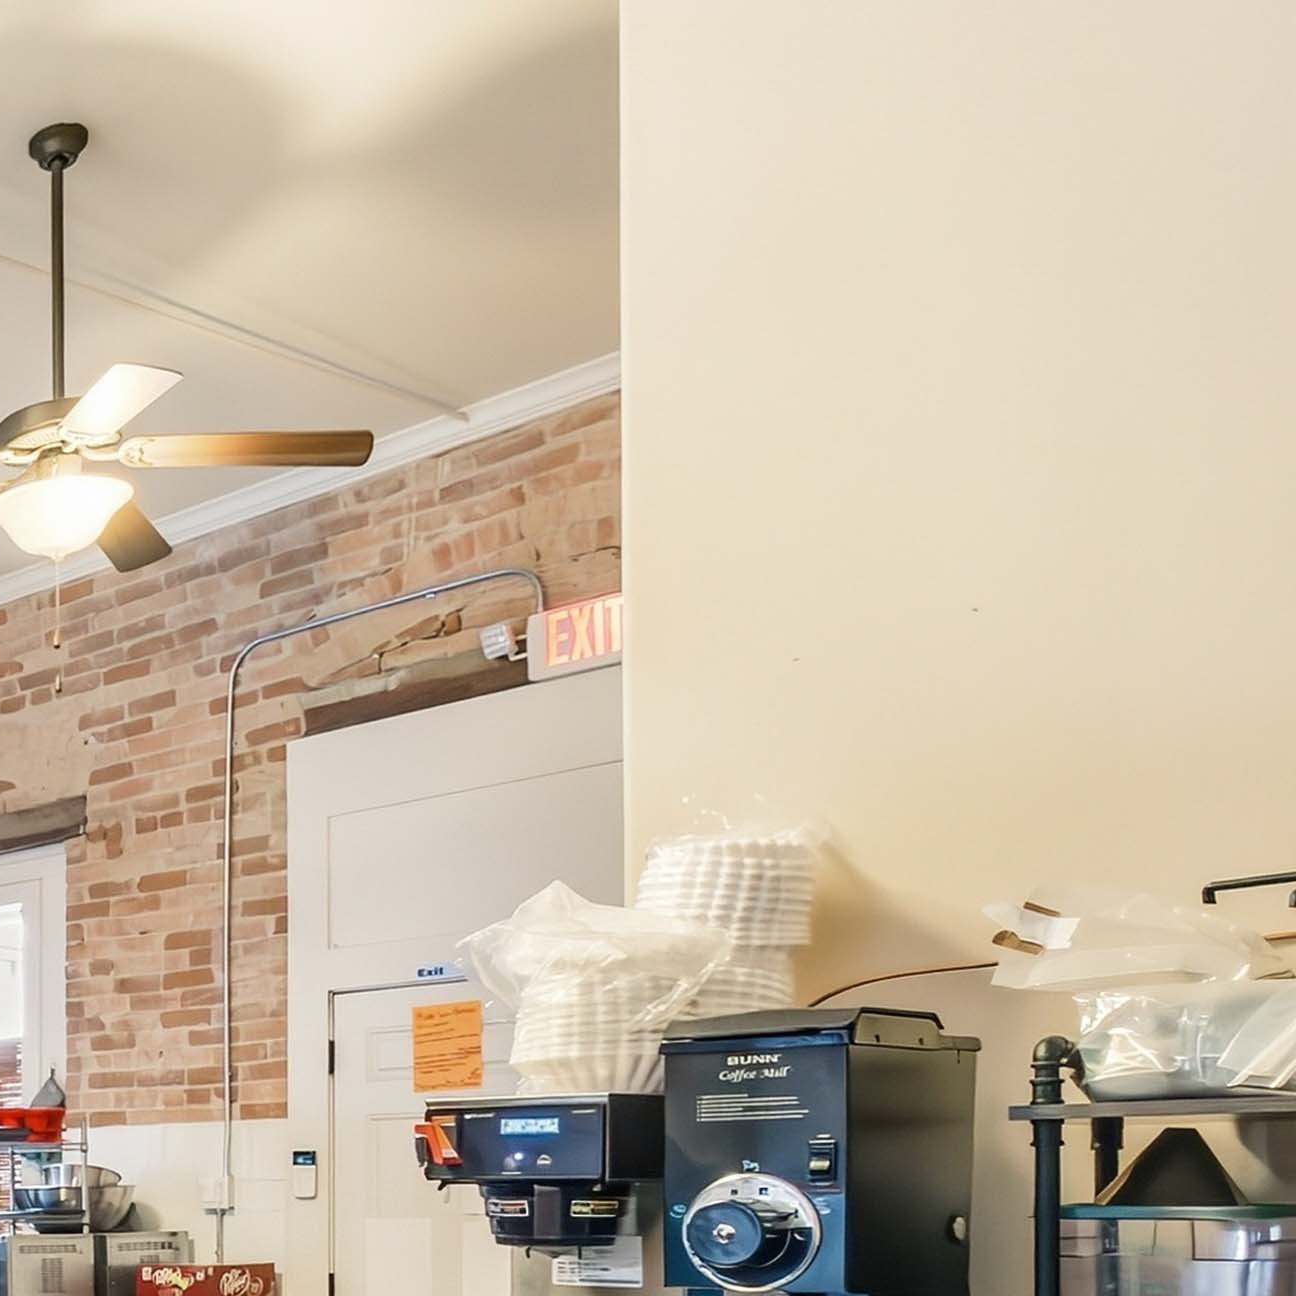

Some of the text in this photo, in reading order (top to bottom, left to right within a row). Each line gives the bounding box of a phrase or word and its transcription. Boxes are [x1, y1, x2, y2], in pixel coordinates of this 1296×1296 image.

[547, 597, 624, 667] EXIT
[726, 1053, 782, 1066] BUNN
[718, 1065, 792, 1084] Coffee Mill
